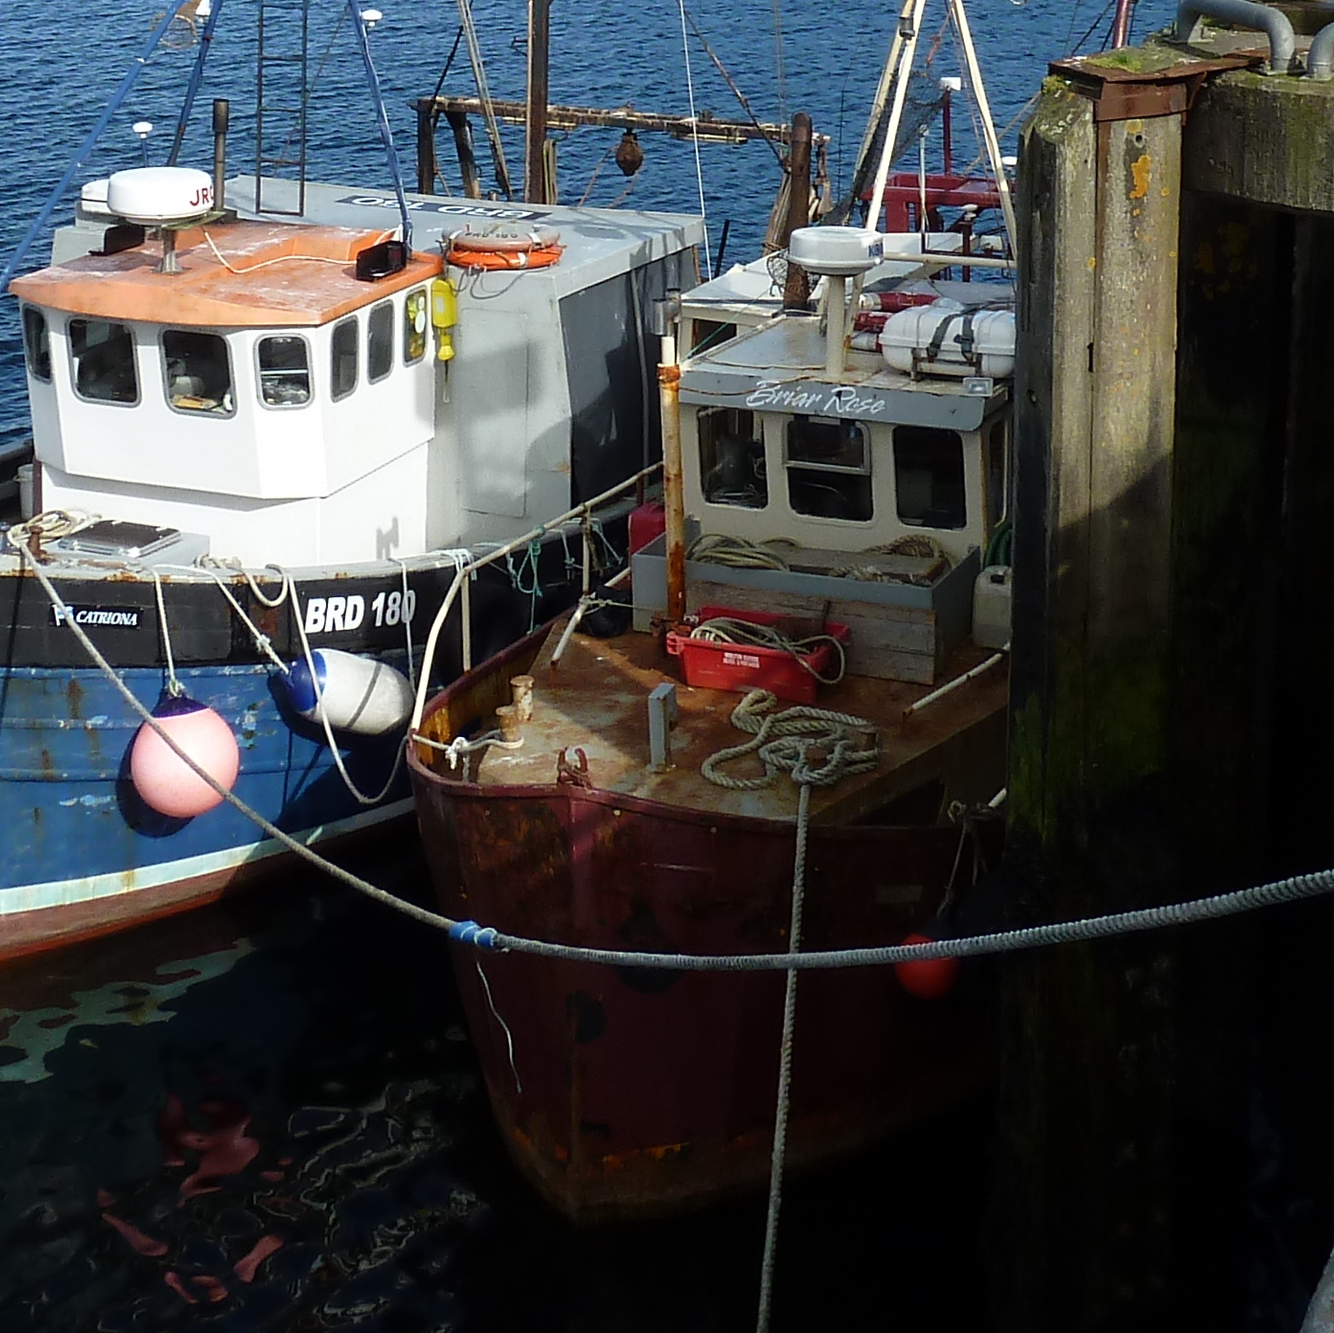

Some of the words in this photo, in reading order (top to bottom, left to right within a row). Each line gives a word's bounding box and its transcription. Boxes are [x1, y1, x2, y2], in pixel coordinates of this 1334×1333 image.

[352, 197, 424, 210] 180
[438, 205, 534, 219] BRD
[745, 379, 822, 409] Briar
[823, 385, 886, 415] Rose
[75, 609, 138, 626] CATRIONA
[304, 594, 365, 634] BRD
[371, 589, 416, 628] 180
